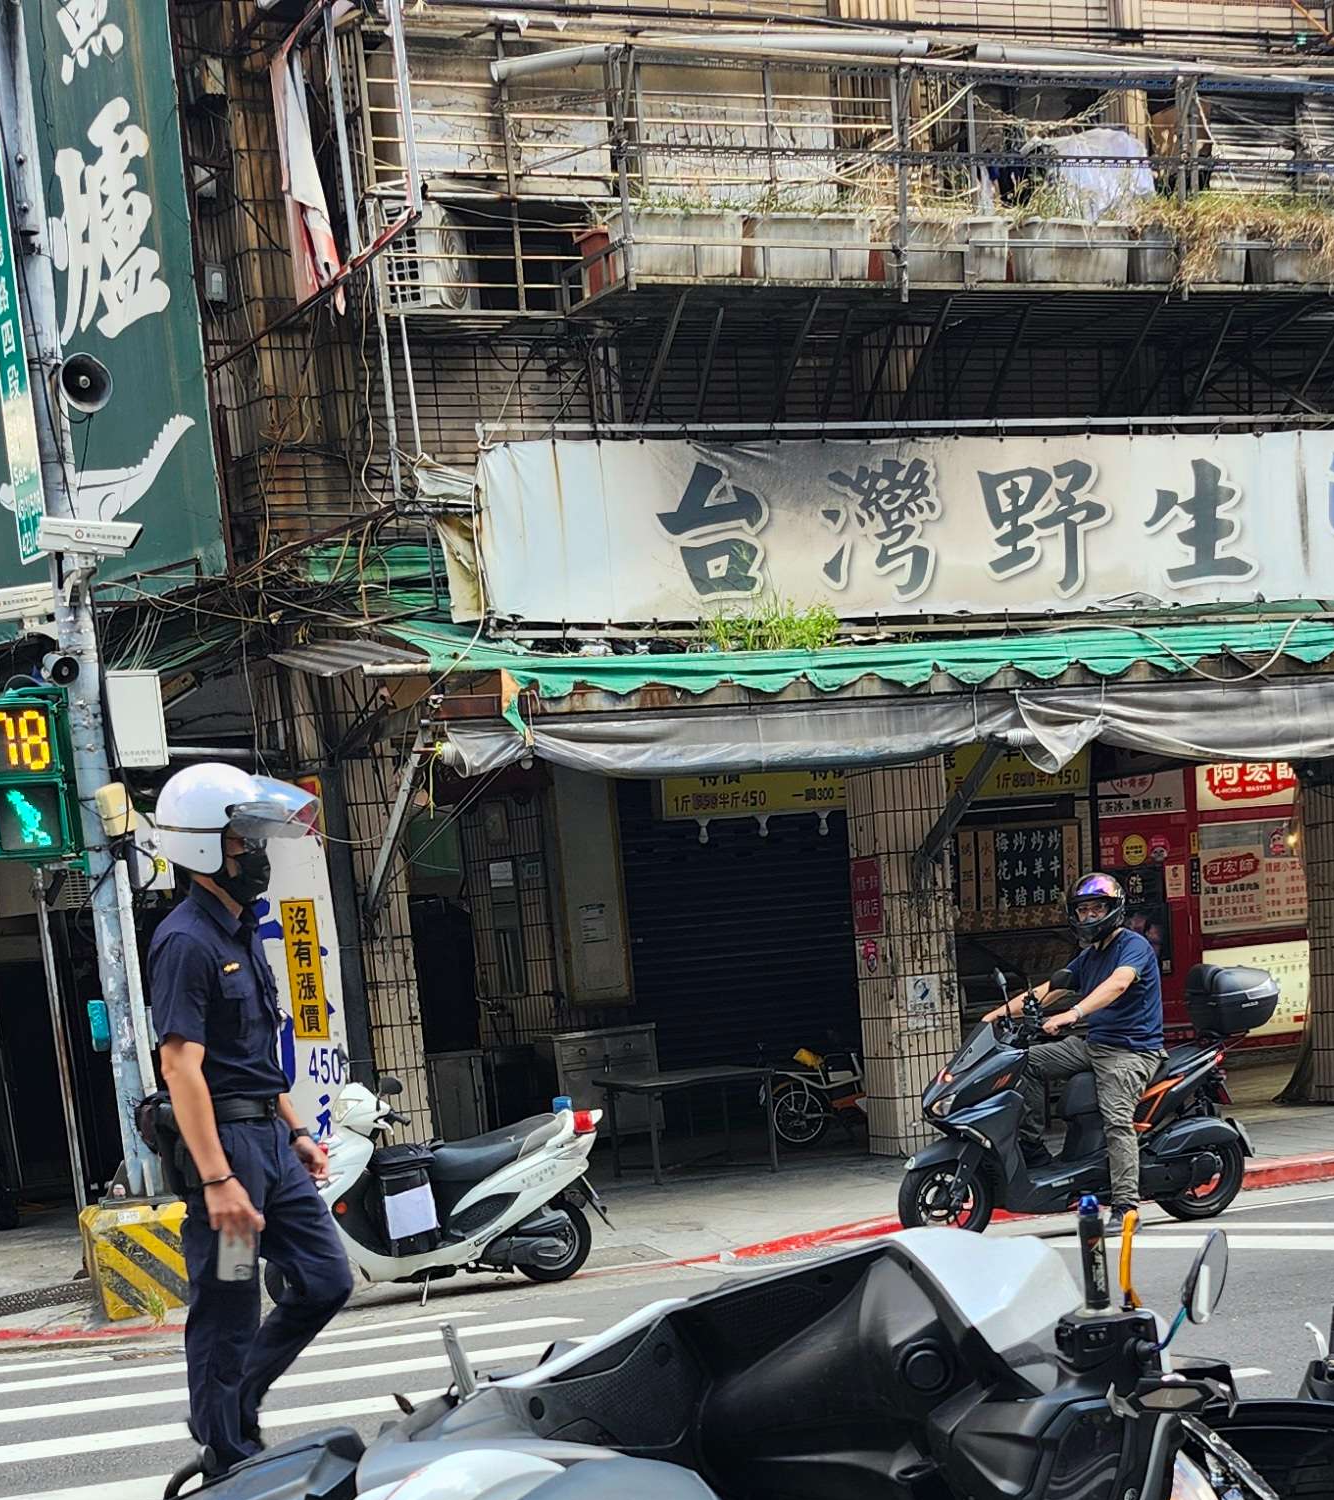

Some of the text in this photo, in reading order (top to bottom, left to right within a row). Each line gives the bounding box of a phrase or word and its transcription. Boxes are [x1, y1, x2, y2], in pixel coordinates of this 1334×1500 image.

[289, 906, 322, 1033] 沒有漲價
[308, 1047, 342, 1085] 450
